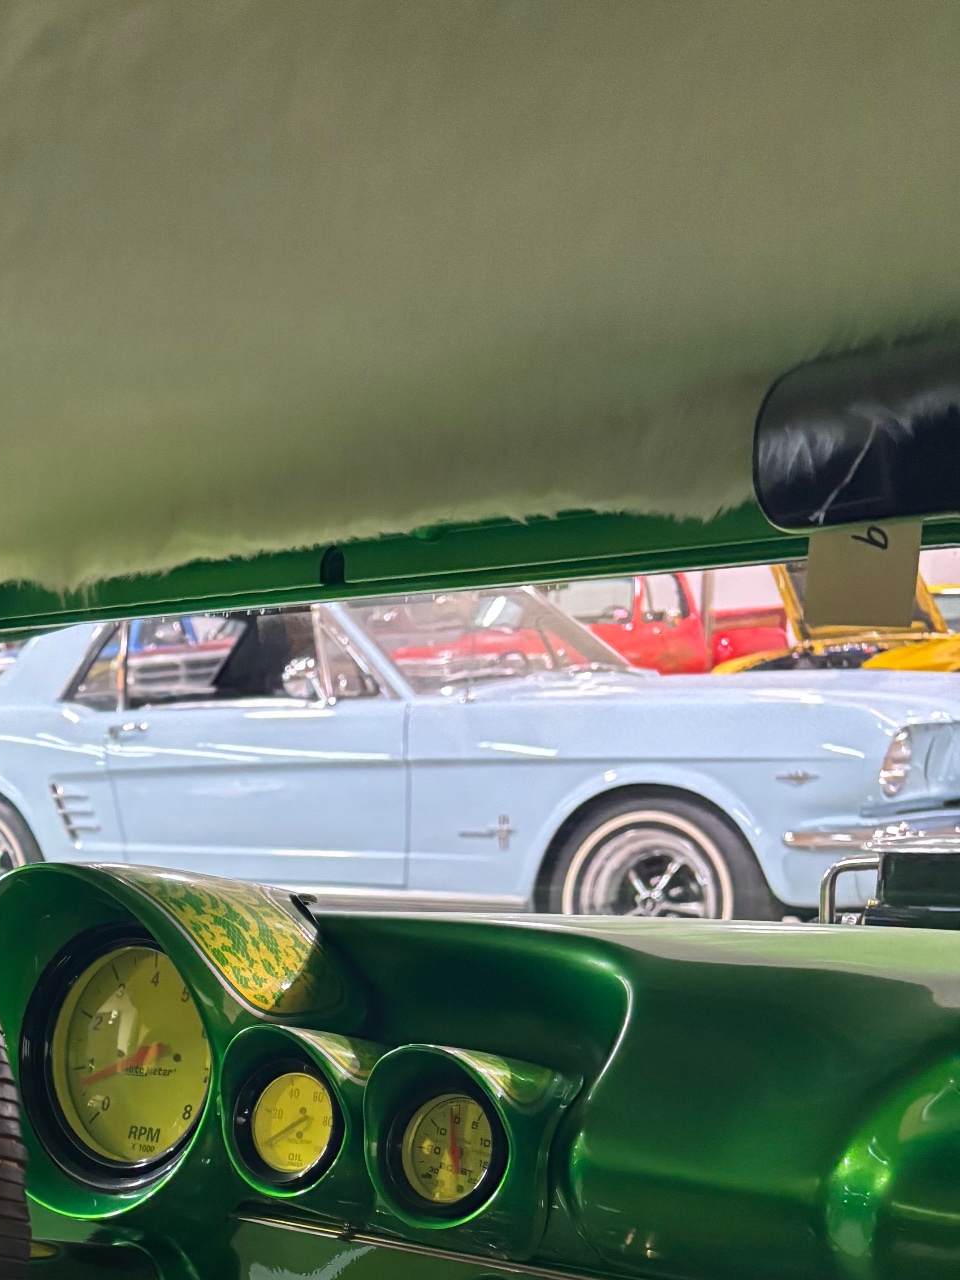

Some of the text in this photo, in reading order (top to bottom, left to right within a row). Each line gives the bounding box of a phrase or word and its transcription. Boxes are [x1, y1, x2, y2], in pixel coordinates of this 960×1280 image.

[150, 971, 160, 988] 4
[115, 983, 126, 999] 3
[180, 986, 190, 1003] 5
[92, 1016, 103, 1031] 2
[288, 1087, 300, 1099] 40
[312, 1091, 324, 1103] 60
[101, 1096, 111, 1112] 0
[182, 1104, 193, 1120] 8
[272, 1108, 284, 1120] 20
[127, 1125, 161, 1143] RPM
[436, 1126, 447, 1136] 10
[139, 1144, 155, 1154] 1000
[480, 1138, 491, 1147] 10
[287, 1153, 303, 1161] OIL
